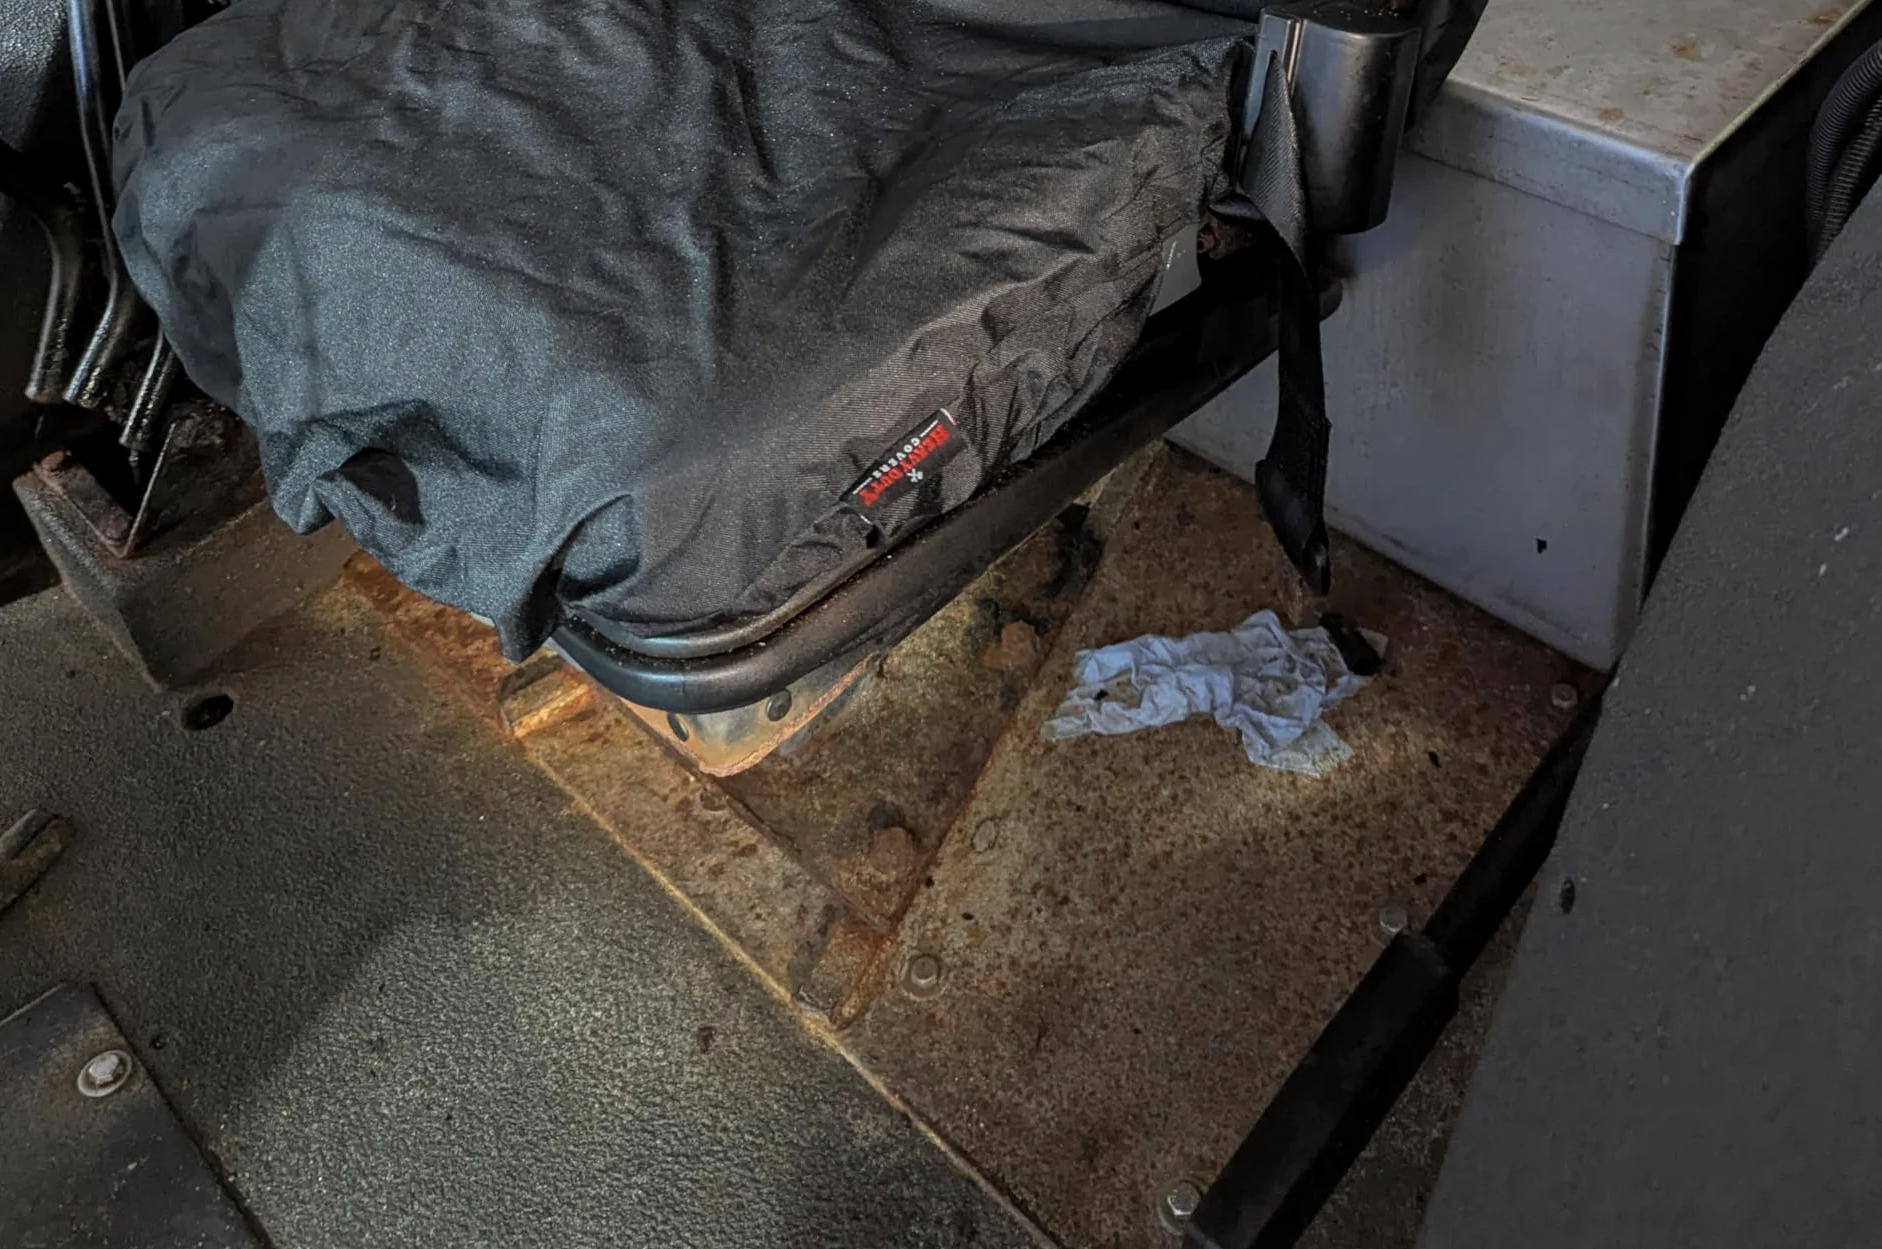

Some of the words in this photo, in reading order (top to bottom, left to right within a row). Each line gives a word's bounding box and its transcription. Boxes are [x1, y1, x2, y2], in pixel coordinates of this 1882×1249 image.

[872, 437, 921, 479] COVERS
[900, 423, 950, 474] HEAVY
[858, 465, 904, 508] DUTY
